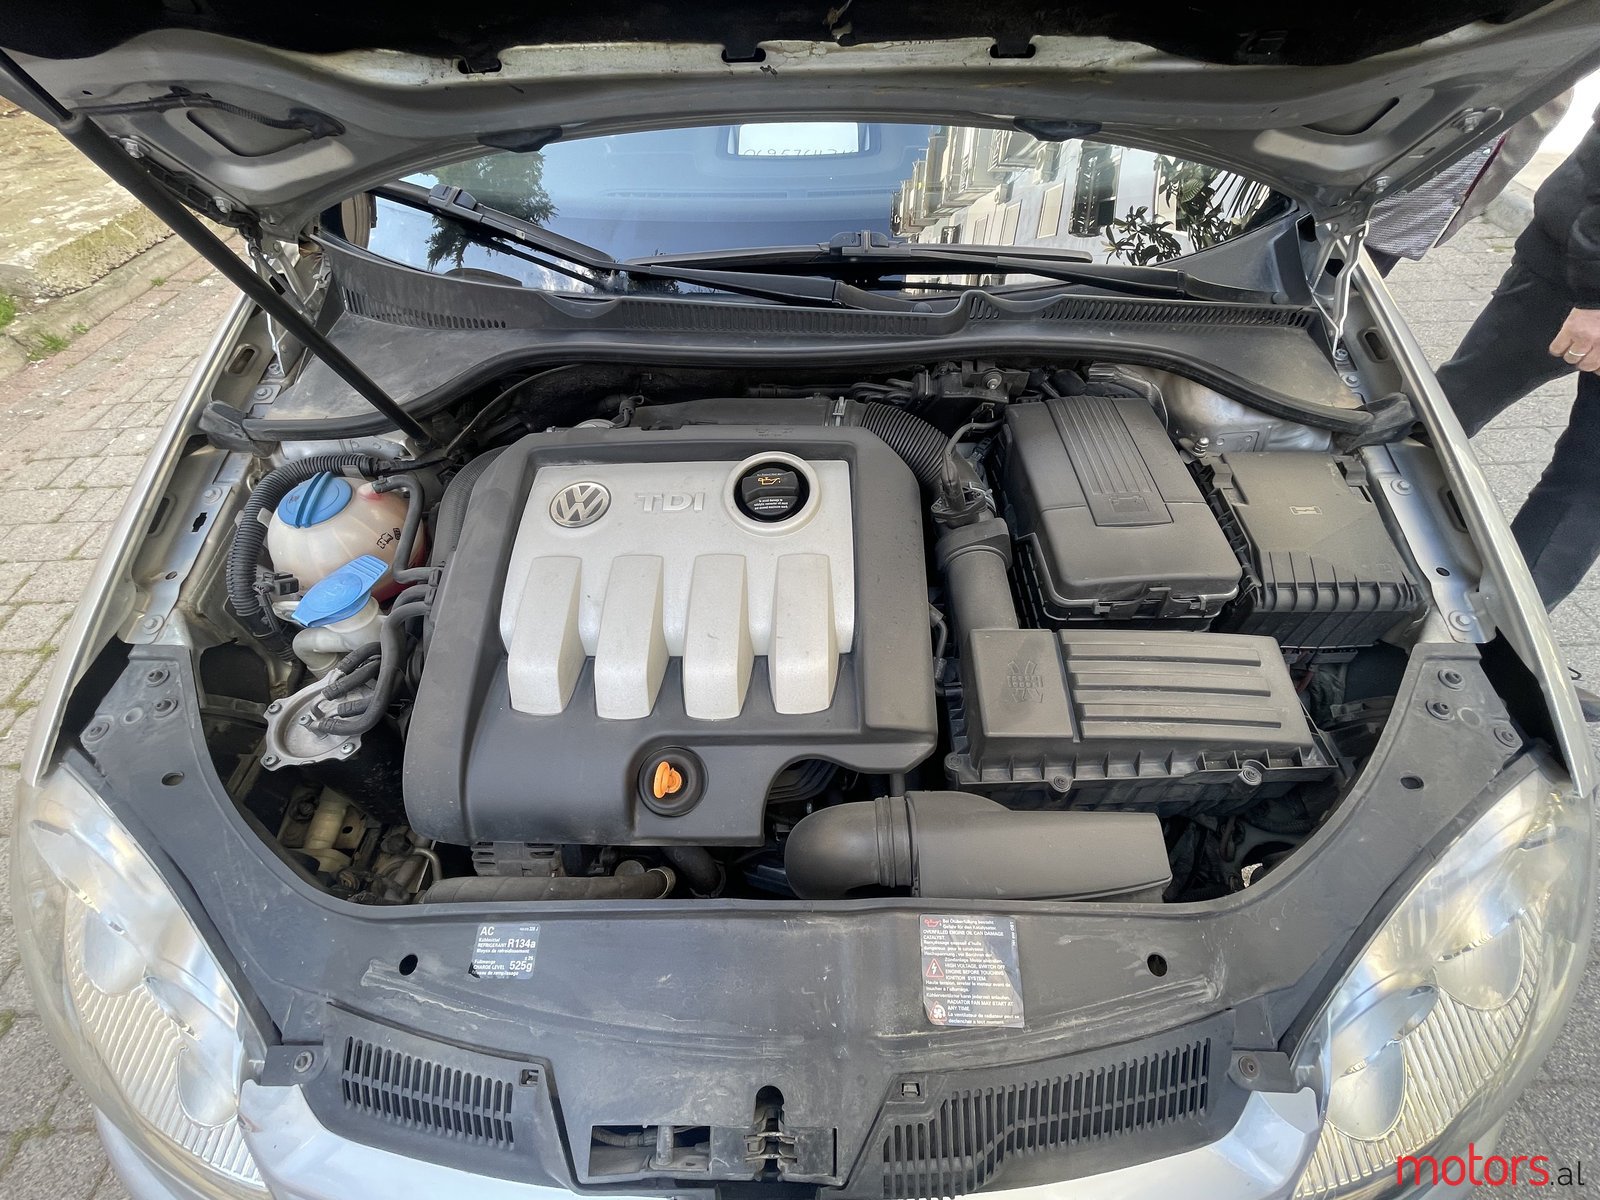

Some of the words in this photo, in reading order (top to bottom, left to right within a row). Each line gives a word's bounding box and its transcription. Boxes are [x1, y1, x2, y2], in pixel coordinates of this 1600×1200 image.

[636, 492, 705, 511] TDI
[480, 926, 494, 936] AC
[507, 938, 536, 948] R134a
[509, 961, 532, 972] 525g
